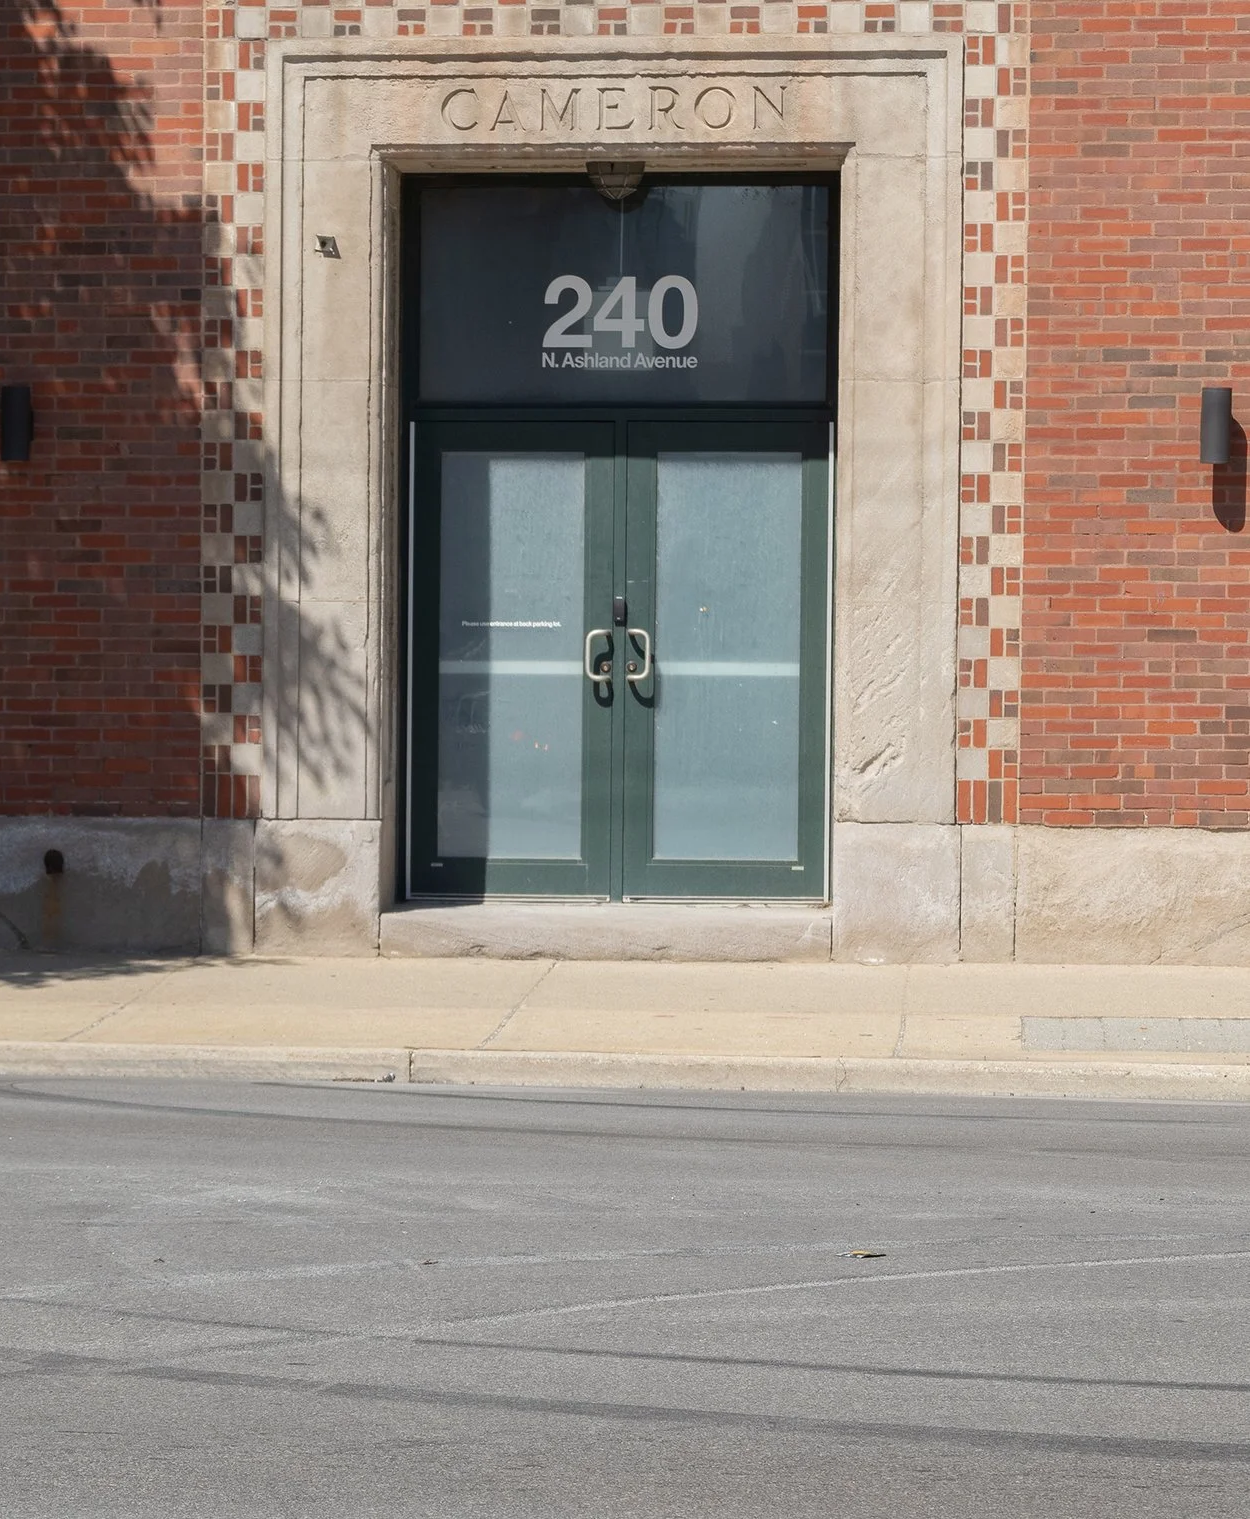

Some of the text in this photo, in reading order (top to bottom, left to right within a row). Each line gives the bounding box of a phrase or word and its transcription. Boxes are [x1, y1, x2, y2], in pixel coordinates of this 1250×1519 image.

[441, 86, 788, 131] CAMERON
[542, 275, 699, 350] 240
[541, 352, 699, 369] N. Ashland Avenue
[532, 620, 553, 628] parking
